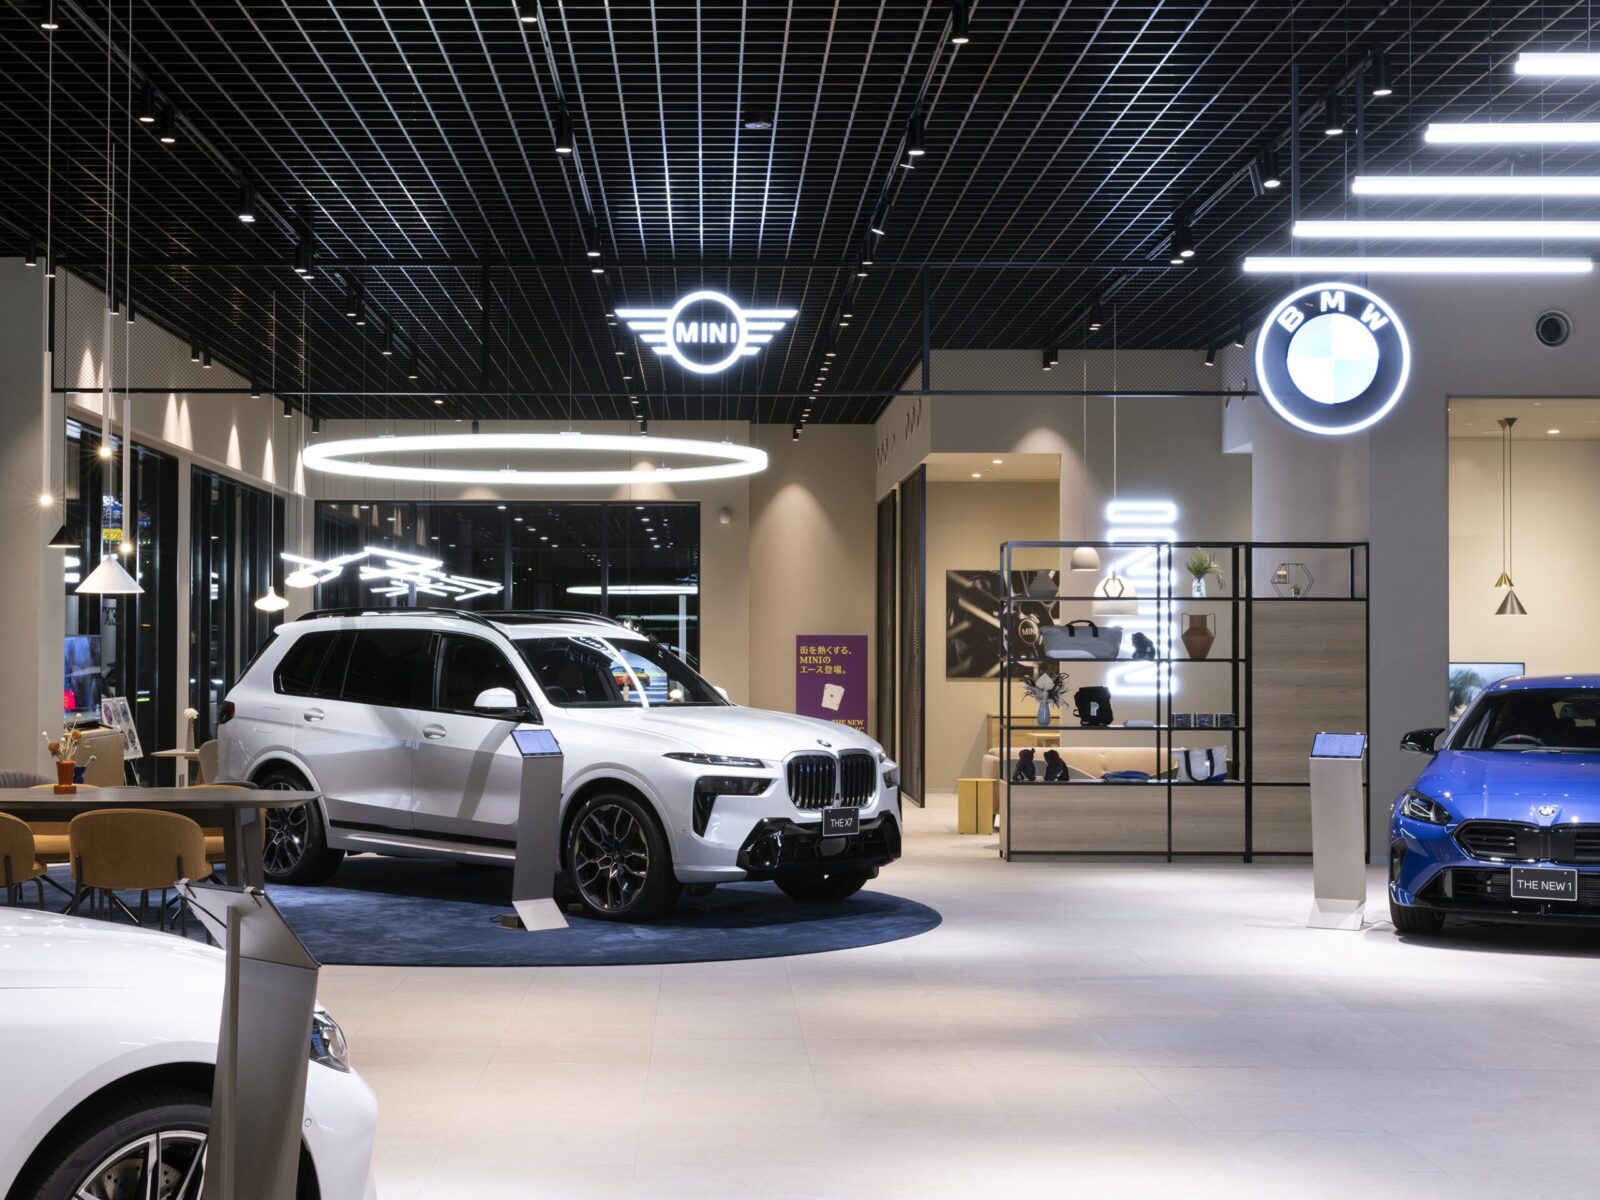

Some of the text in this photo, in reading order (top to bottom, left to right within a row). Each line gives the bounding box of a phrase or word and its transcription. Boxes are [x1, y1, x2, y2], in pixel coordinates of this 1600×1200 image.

[1277, 291, 1389, 333] BMW
[676, 322, 737, 343] MINI
[800, 656, 831, 664] MINIの
[830, 818, 853, 828] THE X7
[1517, 880, 1572, 891] THE NEW 1
